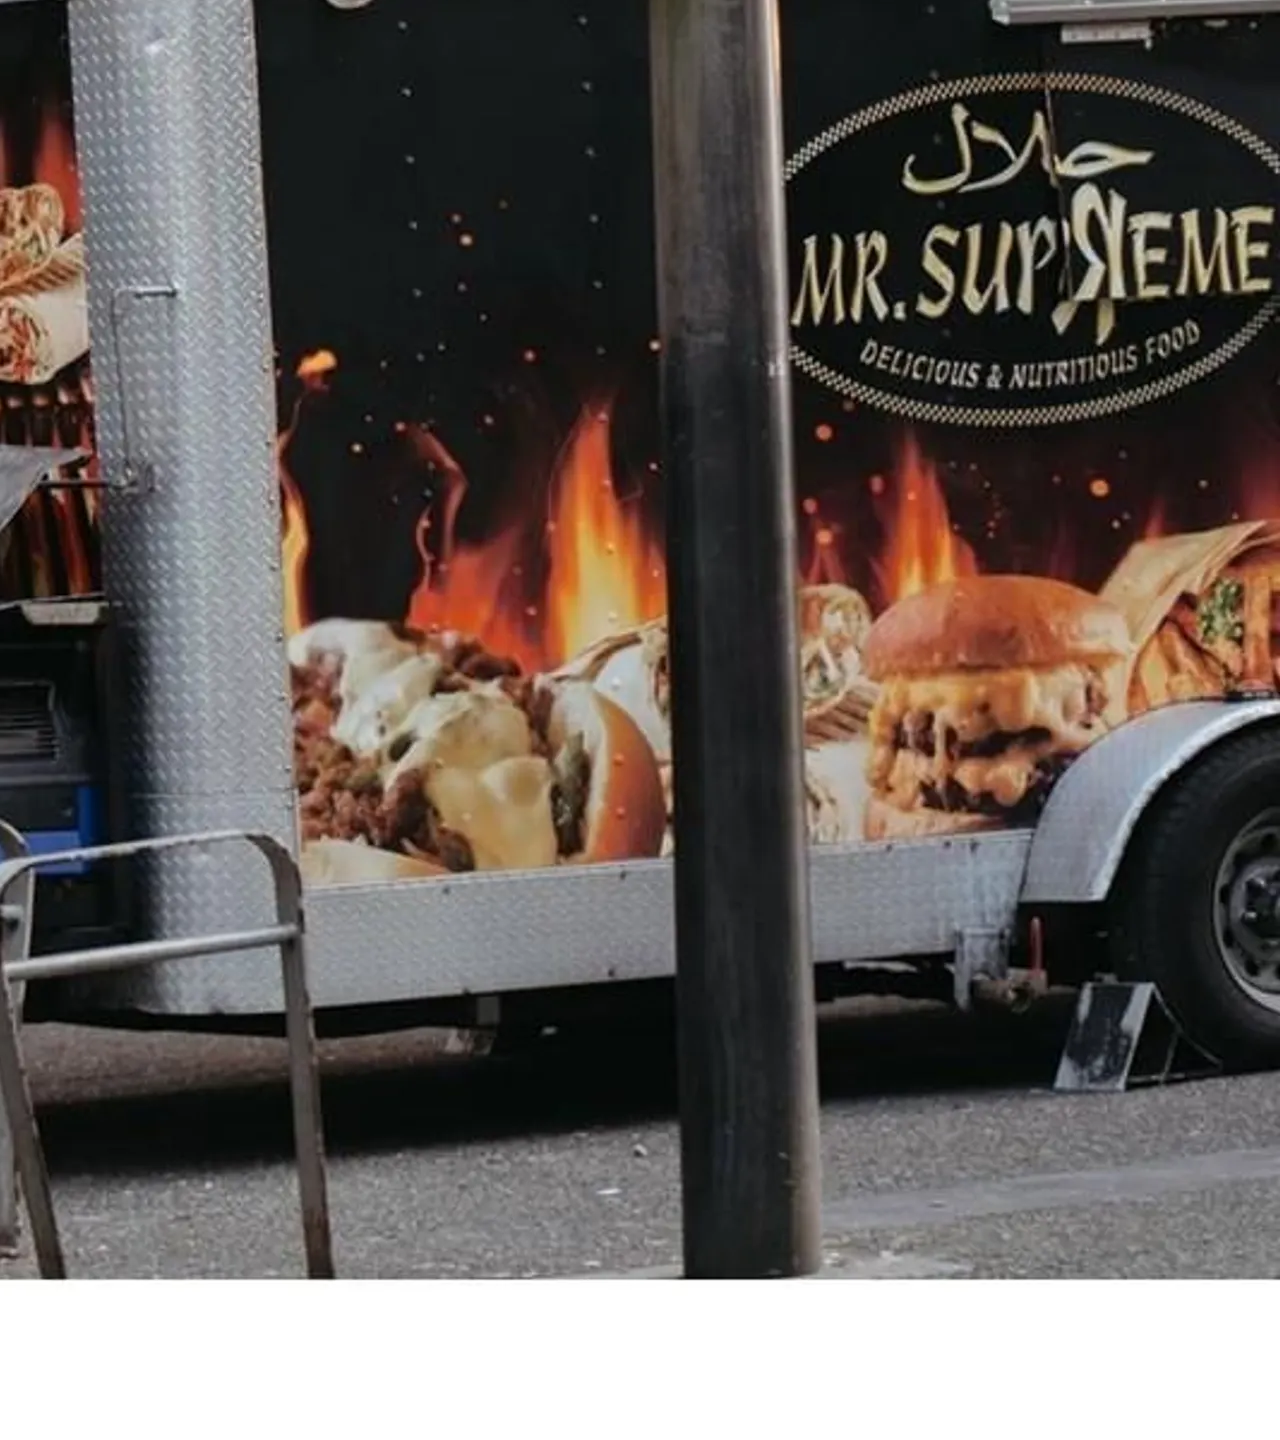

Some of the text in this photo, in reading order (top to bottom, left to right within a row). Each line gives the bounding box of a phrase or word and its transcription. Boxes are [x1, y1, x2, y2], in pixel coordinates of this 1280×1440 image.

[901, 102, 1156, 194] حلال
[790, 183, 1276, 345] MR. SUPREME
[859, 319, 1201, 389] DELICIOUS & NUTRITIOUS FOOD
